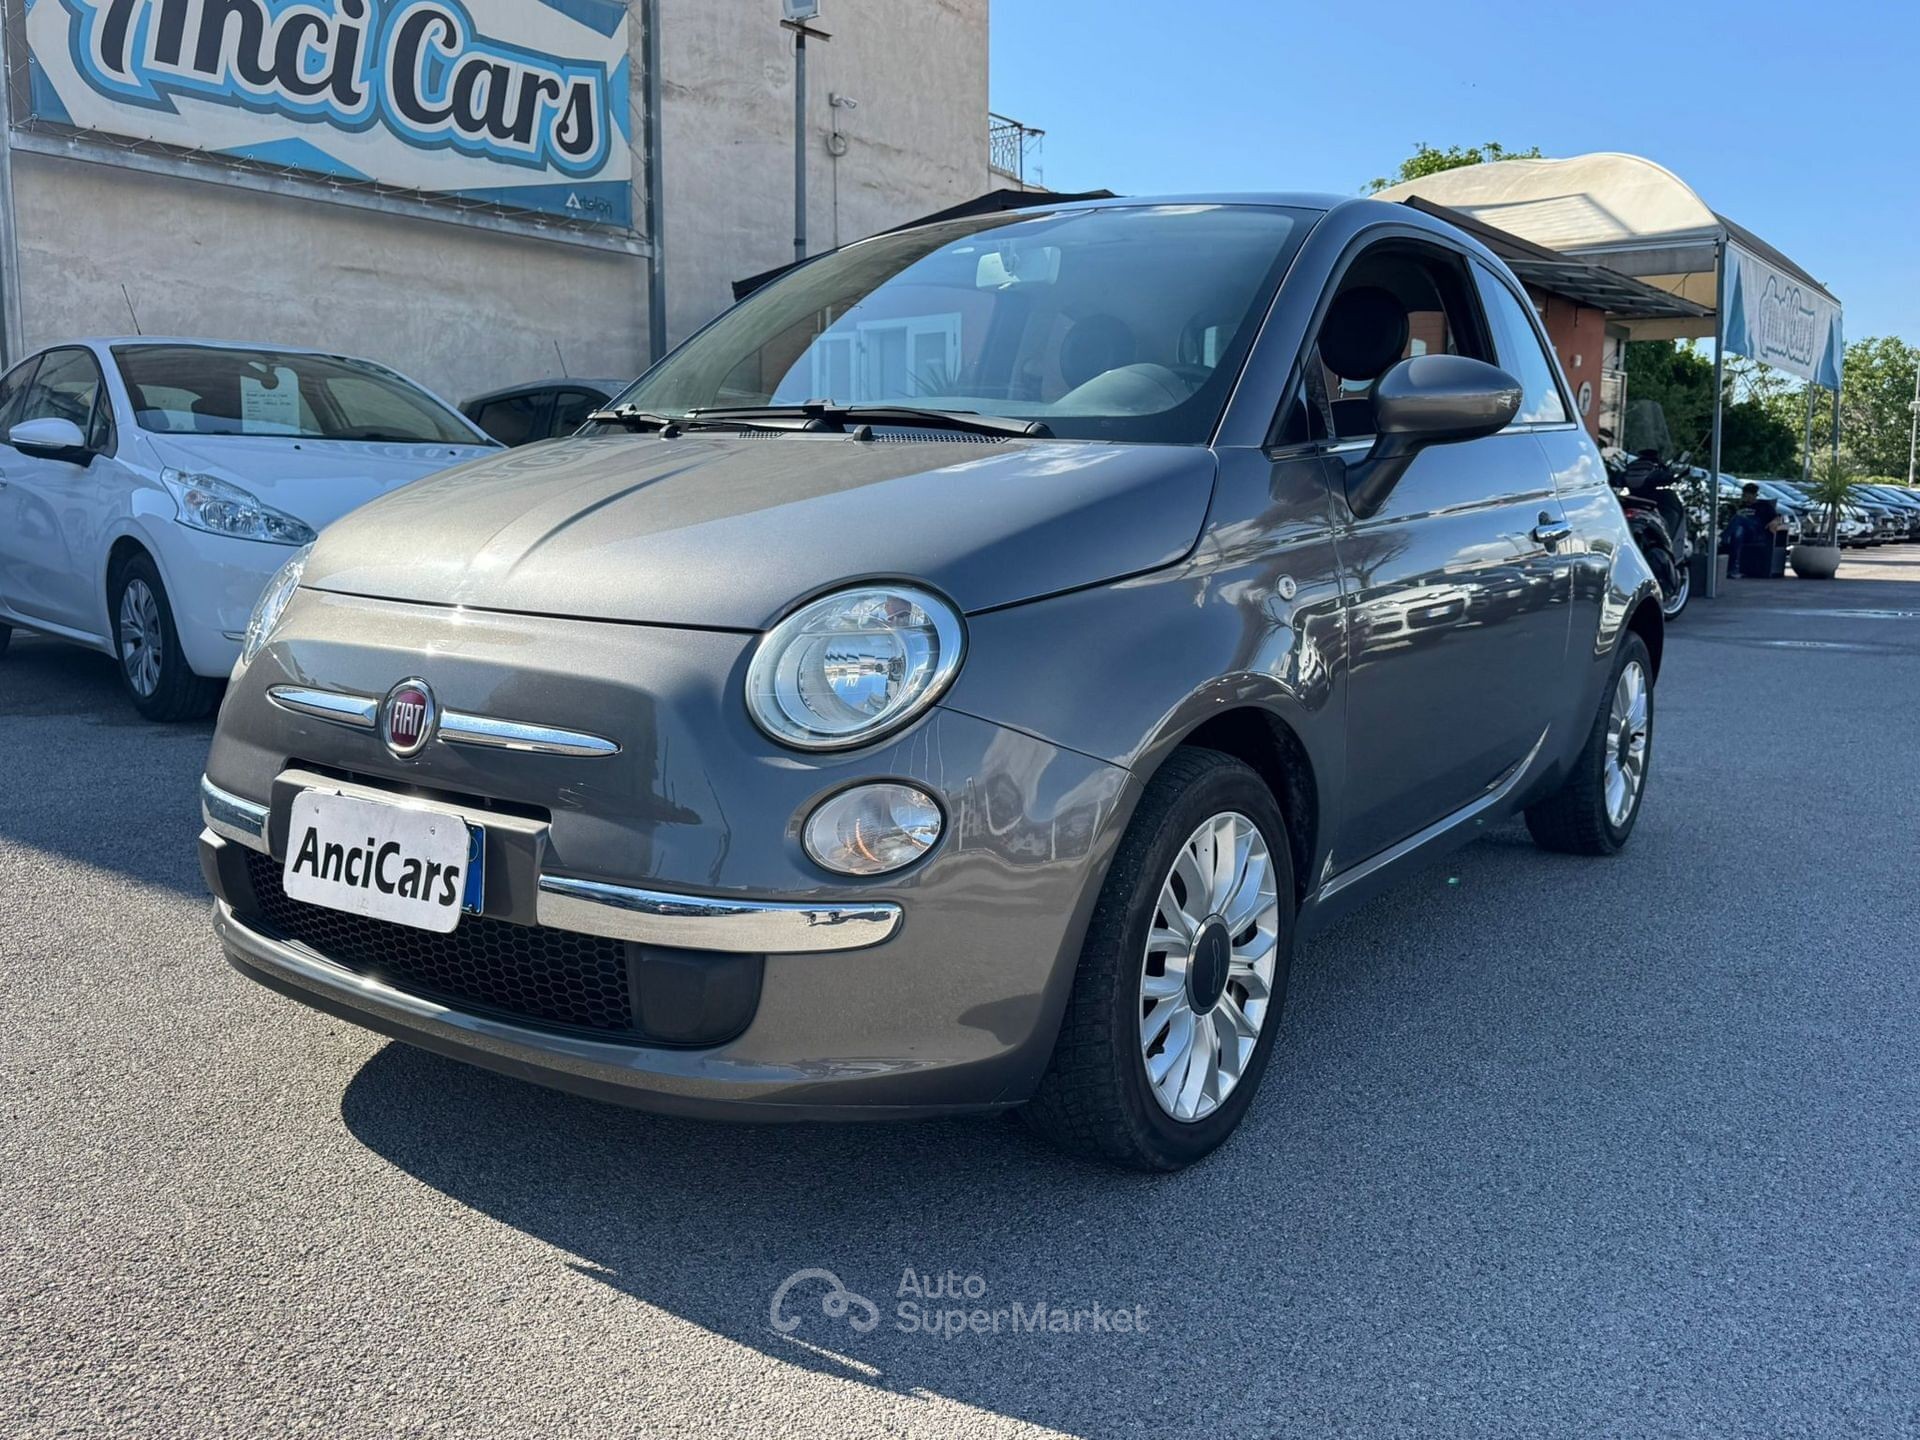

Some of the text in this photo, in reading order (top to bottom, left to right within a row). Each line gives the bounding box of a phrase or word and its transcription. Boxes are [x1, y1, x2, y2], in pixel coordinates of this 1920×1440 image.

[393, 10, 593, 155] Cars
[392, 701, 424, 736] FIAT
[292, 827, 459, 906] AnciCars
